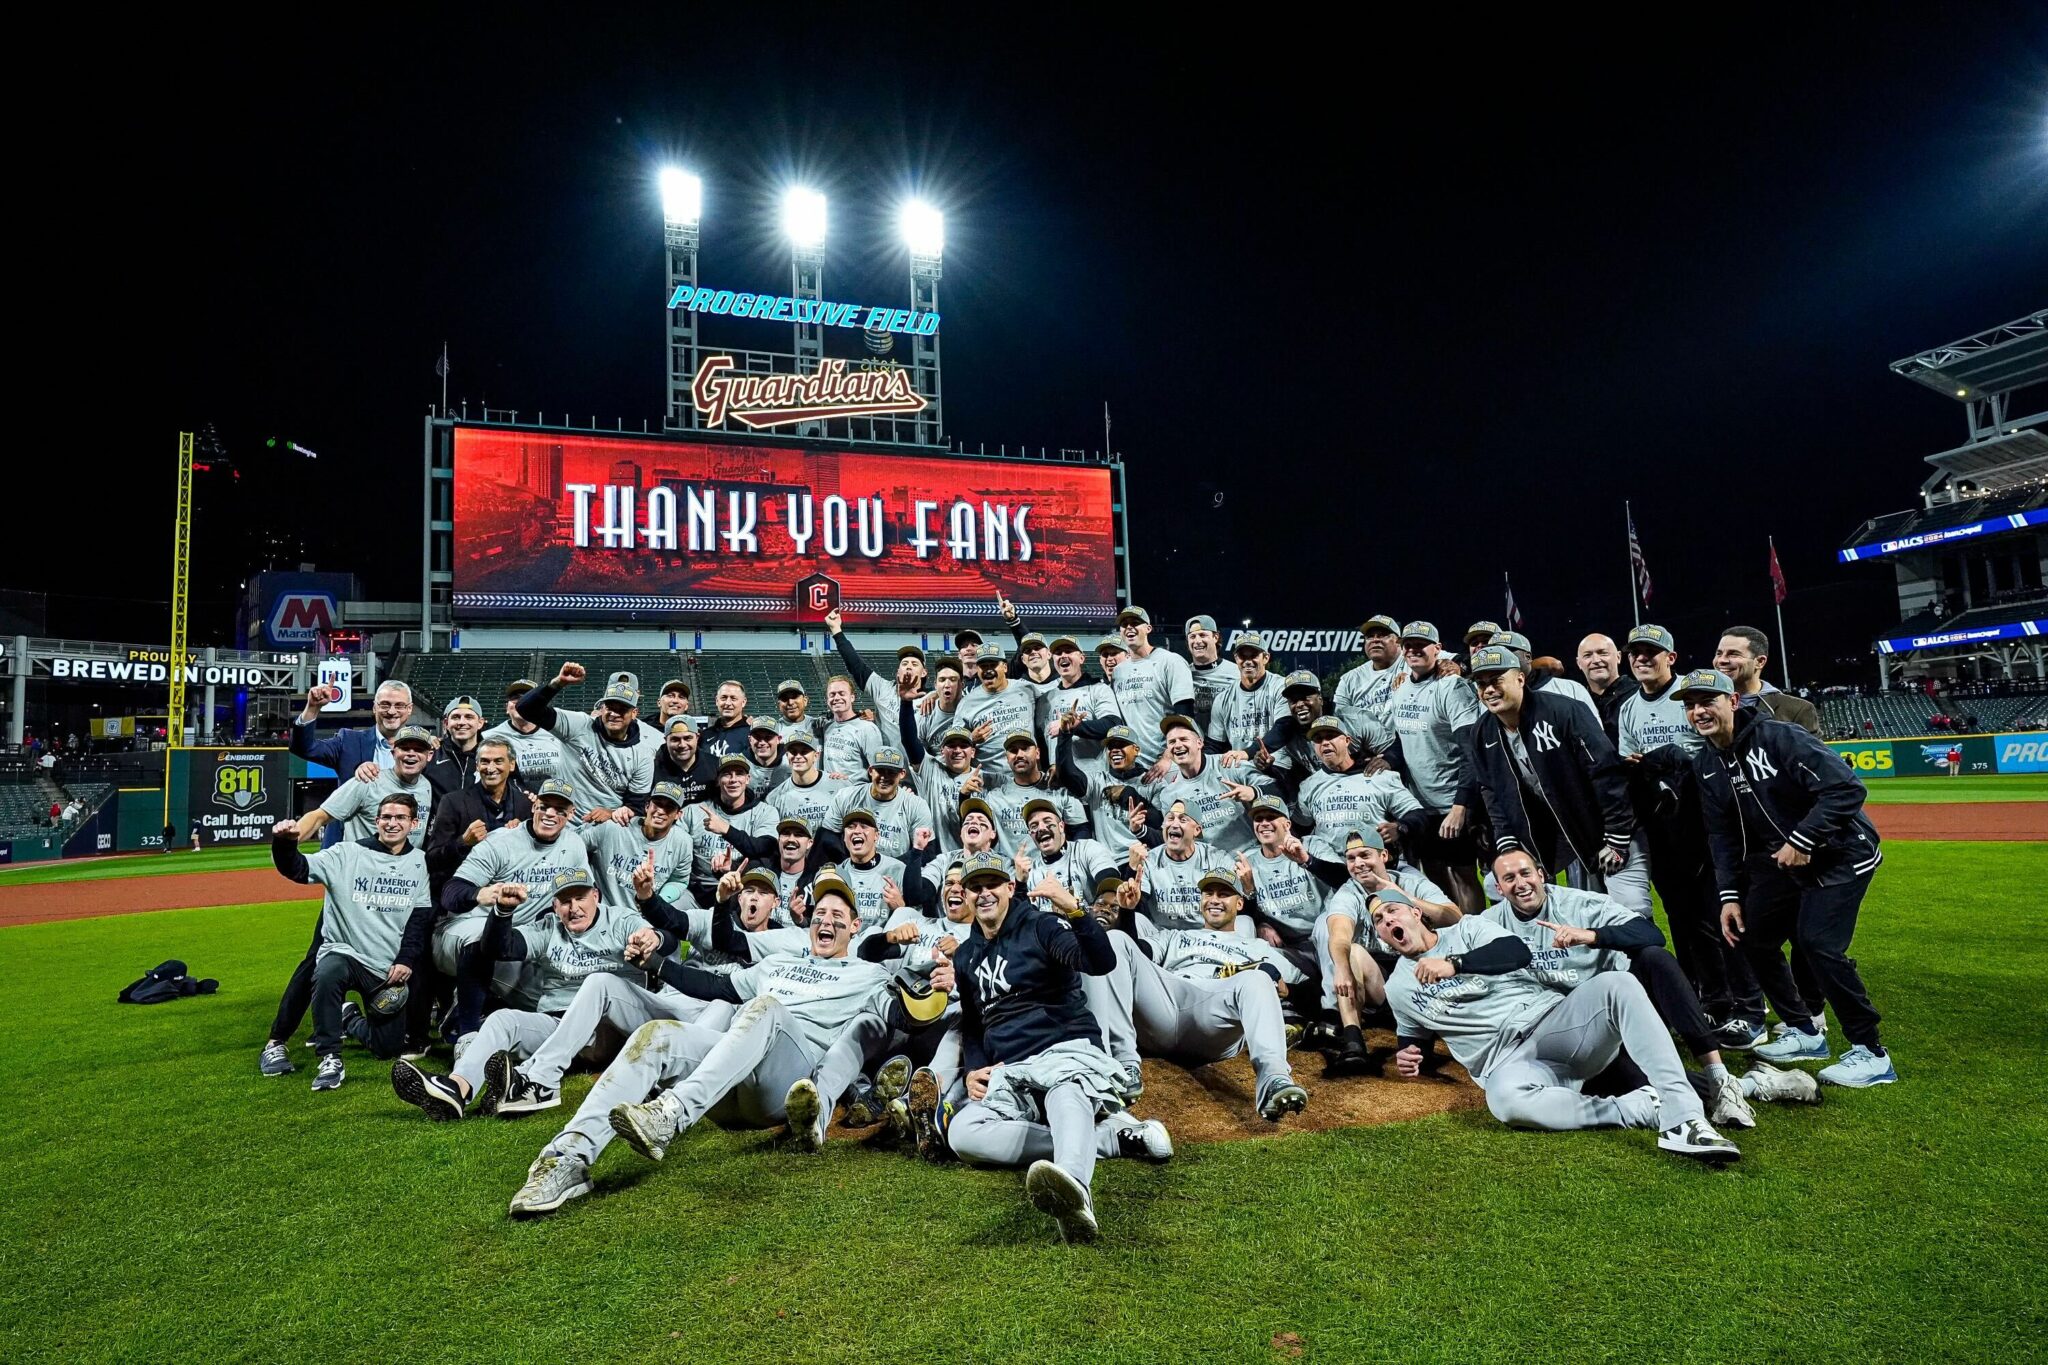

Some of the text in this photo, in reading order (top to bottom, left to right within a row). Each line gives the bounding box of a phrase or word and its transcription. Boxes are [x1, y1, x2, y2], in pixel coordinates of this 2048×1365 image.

[667, 284, 941, 335] PROGRESSIVE FIELD
[692, 356, 928, 428] Guardians
[566, 483, 1032, 562] THANK YOU FANS
[809, 584, 828, 611] C
[278, 629, 318, 639] Marat
[1226, 630, 1365, 652] POGRESSIVE
[53, 659, 166, 681] BREWED
[205, 667, 262, 685] OHIO
[1195, 686, 1226, 694] AMERICA
[992, 706, 1028, 717] AMERICAN
[1400, 703, 1430, 712] AMERICAN
[992, 713, 1020, 724] LEAGUE
[1397, 711, 1420, 719] LEAGUE
[1531, 719, 1561, 753] NY
[1642, 725, 1688, 736] AMERICAN
[1643, 735, 1675, 744] LEAGUE
[521, 752, 559, 761] AMERICAN
[521, 759, 552, 767] LEAGUE
[1746, 746, 1778, 782] NY
[219, 769, 260, 795] 811
[1326, 795, 1370, 804] AMERICAN
[797, 805, 830, 816] AMERICA
[1201, 802, 1221, 813] AGUE
[1326, 803, 1357, 811] LEAGUE
[202, 814, 275, 826] Call before
[879, 823, 902, 834] RICAN
[213, 828, 264, 841] you dig.
[97, 834, 111, 849] GEICO
[141, 836, 163, 846] 325
[1268, 874, 1309, 891] AMERICAN
[374, 885, 410, 896] LEAGUE
[1170, 887, 1201, 895] AMERIC
[1270, 886, 1300, 899] LEAGUE
[352, 892, 414, 907] CHAMPION
[1532, 949, 1569, 961] ERICAN
[567, 957, 603, 967] LEAGUE
[789, 965, 841, 982] AMERICAN
[974, 954, 1012, 1003] NY
